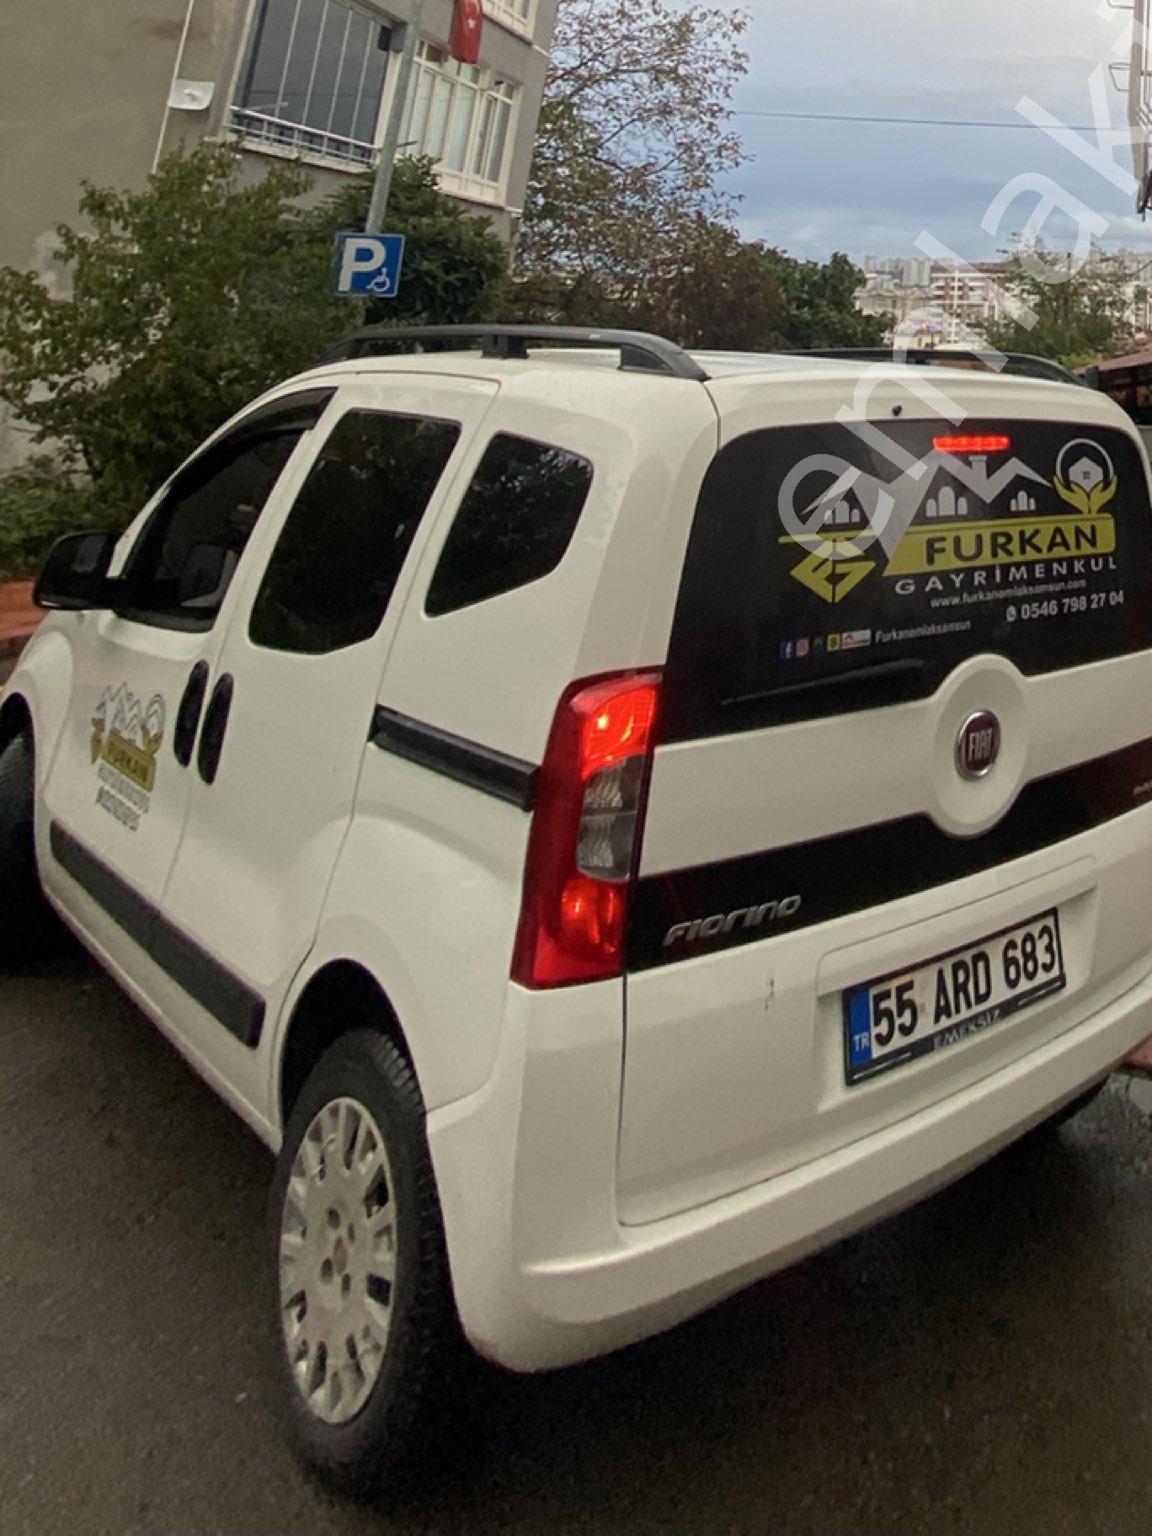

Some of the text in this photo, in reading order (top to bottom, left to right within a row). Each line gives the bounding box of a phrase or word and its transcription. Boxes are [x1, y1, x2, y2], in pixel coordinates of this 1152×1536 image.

[338, 237, 387, 292] P
[925, 523, 1098, 566] FURKAN
[894, 555, 1118, 596] GAYRİMENKUL
[1021, 590, 1124, 621] 0546 798 27 04
[853, 924, 1056, 1052] TR 55 ARD 683
